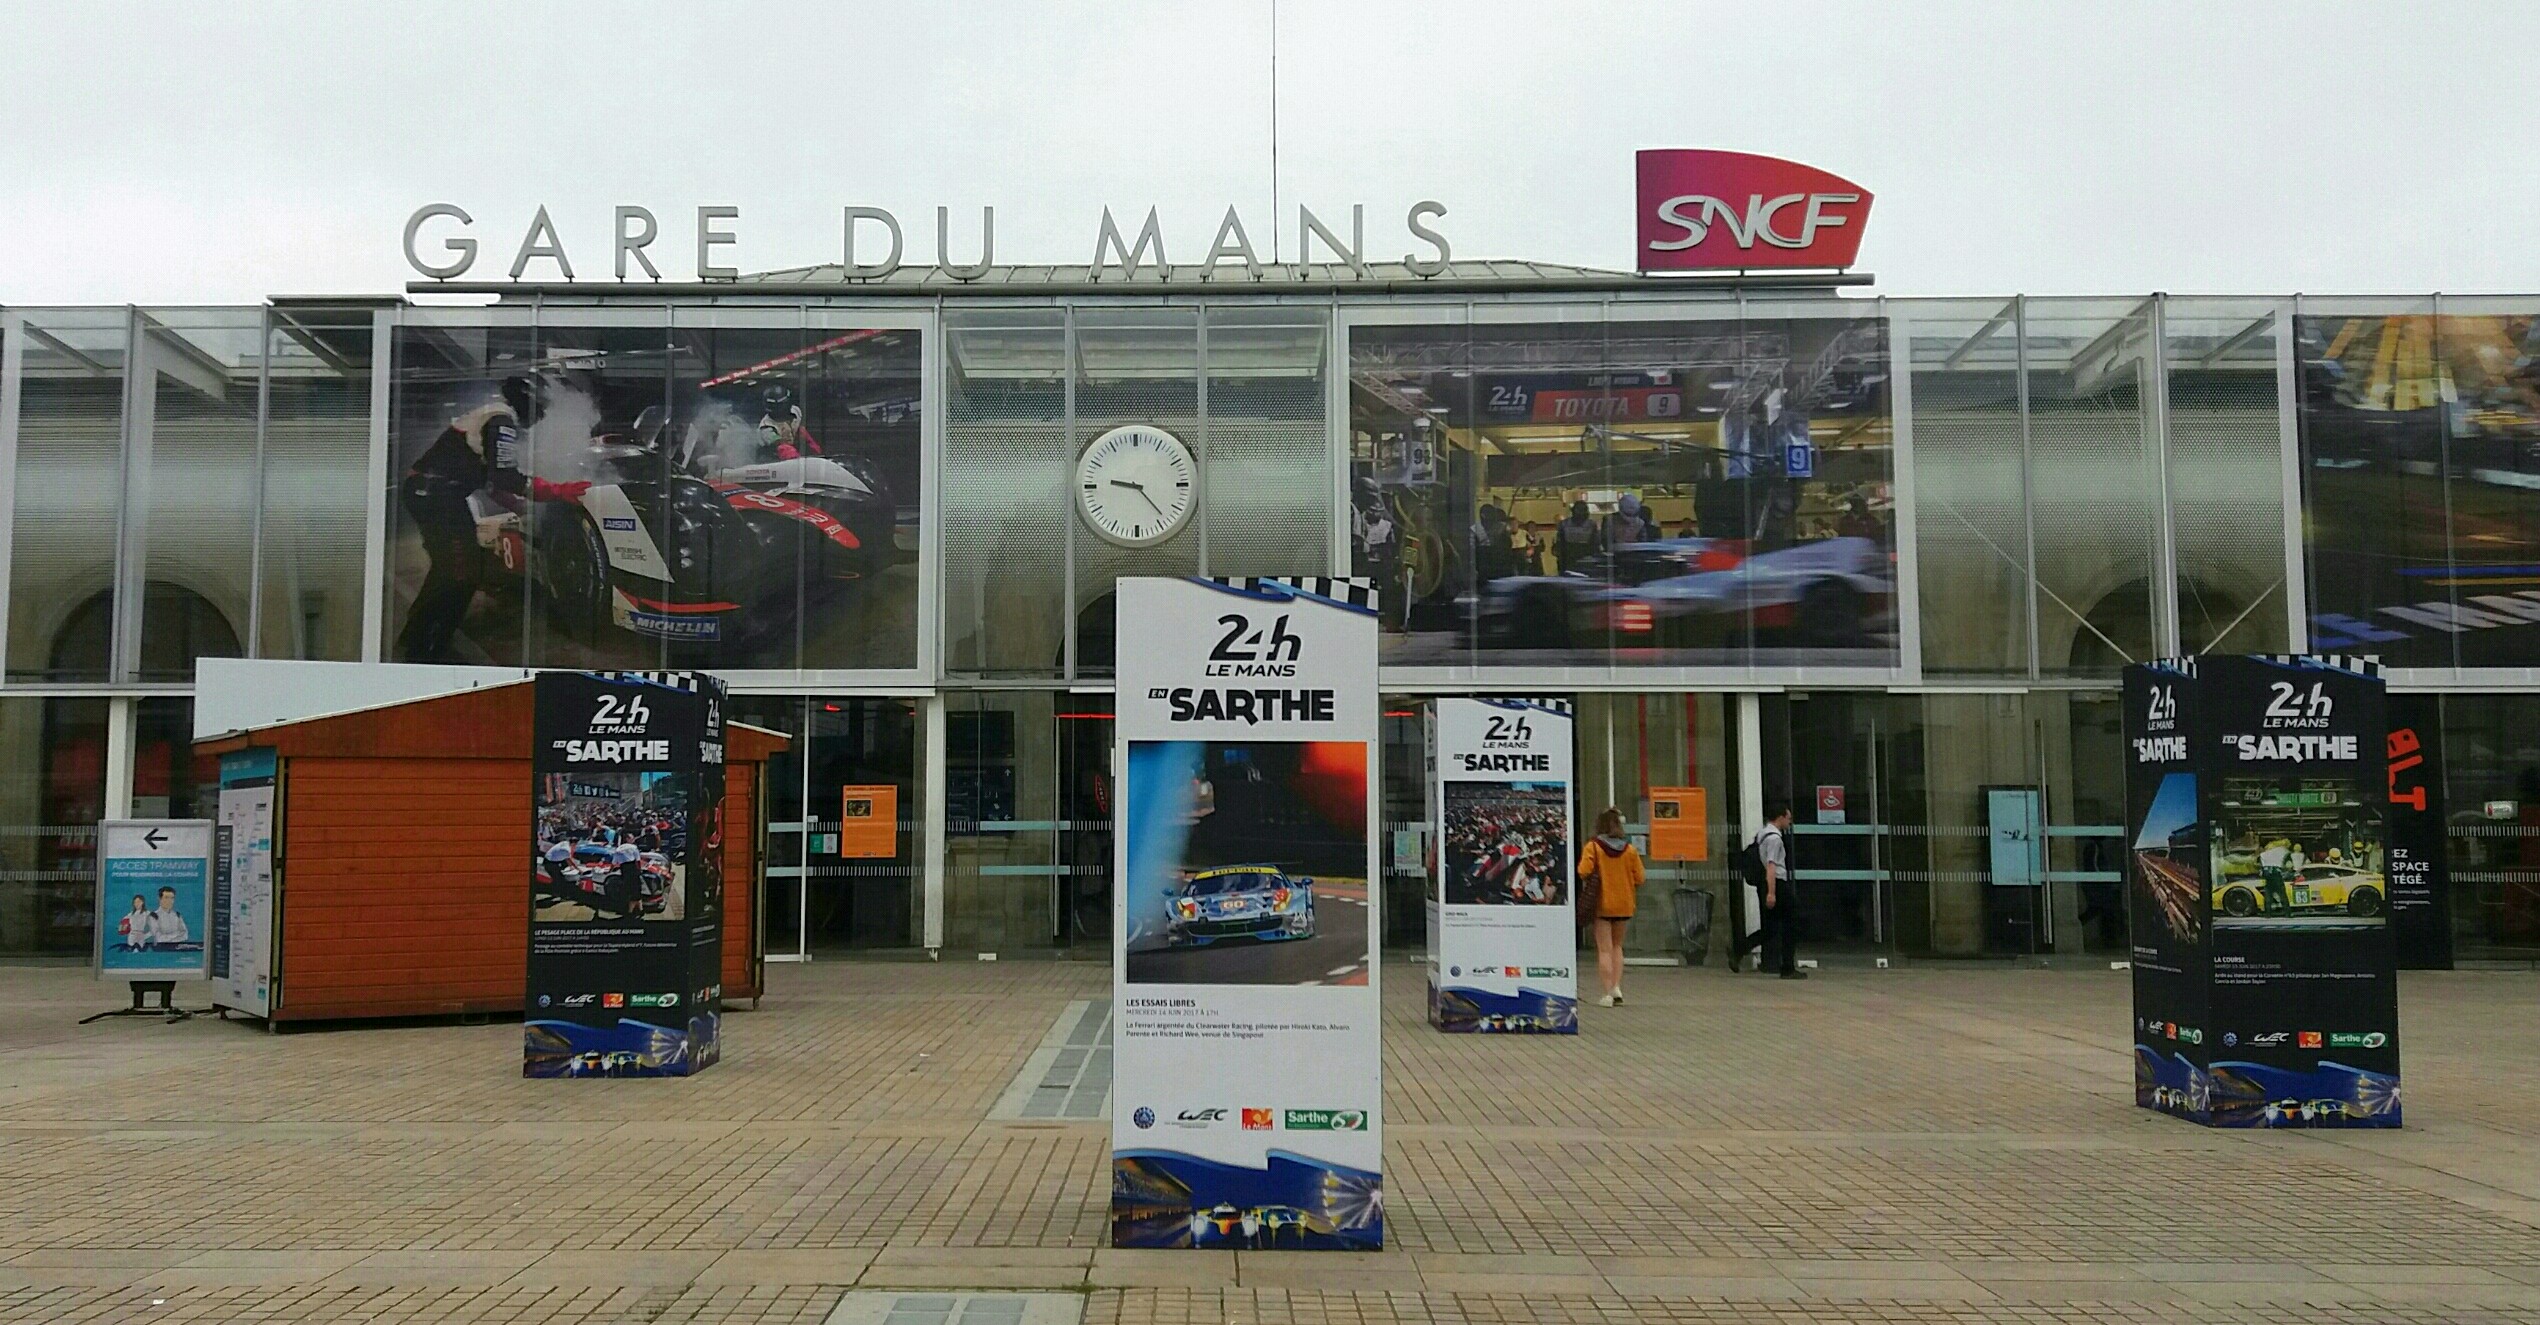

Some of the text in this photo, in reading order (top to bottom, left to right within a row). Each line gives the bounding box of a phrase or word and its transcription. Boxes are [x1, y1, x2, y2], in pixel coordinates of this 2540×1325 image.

[1648, 193, 1860, 251] SNCF
[403, 200, 1452, 280] GARE DU MANS
[1489, 385, 1529, 406] 24h
[1553, 397, 1629, 418] TOYOTA
[1657, 396, 1669, 415] 9
[1791, 447, 1806, 470] 9
[604, 519, 634, 530] AISIN
[502, 536, 514, 570] 8
[636, 616, 716, 634] MICHELIN
[1208, 613, 1302, 662] 24h
[1205, 664, 1296, 677] LE MANS
[1150, 687, 1335, 727] EN SARTHE
[2149, 684, 2176, 720] 24h
[2264, 681, 2334, 718] 24h
[590, 693, 651, 726] 24h
[588, 725, 647, 735] LE MANS
[1484, 715, 1533, 741] 24h
[2262, 717, 2330, 729] LE MANS
[565, 739, 670, 765] SARTHE
[1482, 741, 1530, 749] LE MANS
[2138, 735, 2188, 764] SARTHE
[2222, 735, 2358, 764] EN SARTHE
[1464, 753, 1550, 774] SARTHE
[2295, 889, 2309, 905] 63
[631, 994, 657, 1003] Sarthe
[1125, 998, 1196, 1008] LES ESSAIS LIBRES
[1125, 1008, 1157, 1017] MERCREDI
[1168, 1008, 1182, 1017] JUIN
[1183, 1008, 1199, 1017] 2017
[1125, 1021, 1134, 1029] La
[1134, 1021, 1156, 1029] Ferrari
[1157, 1021, 1185, 1031] argentée
[1186, 1021, 1195, 1030] du
[1196, 1021, 1230, 1030] Clearwater
[1279, 1023, 1290, 1032] par
[1125, 1030, 1151, 1038] Parente
[1151, 1030, 1158, 1038] et
[1159, 1030, 1184, 1038] Richard
[1201, 1031, 1221, 1039] venue
[1222, 1031, 1231, 1039] de
[2253, 1032, 2291, 1042] WEC
[2331, 1033, 2361, 1043] Sarthe
[1177, 1107, 1229, 1122] WEC
[1287, 1110, 1328, 1124] Sarthe
[1242, 1122, 1251, 1131] Le
